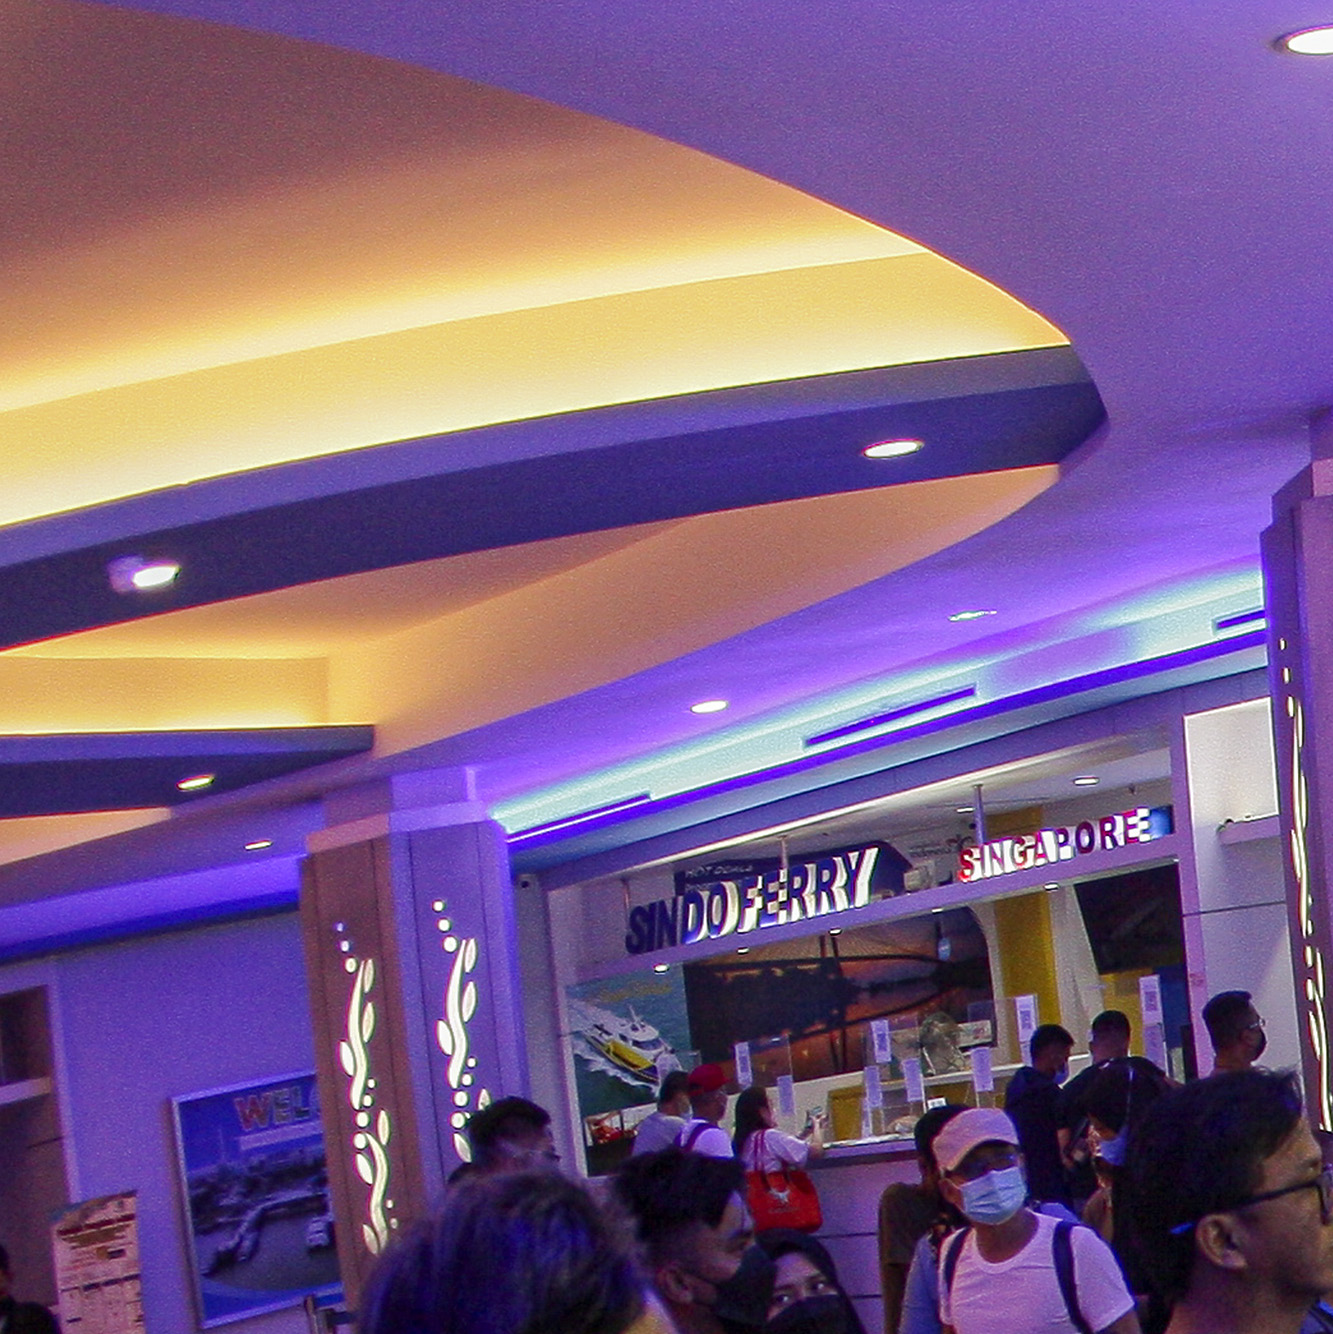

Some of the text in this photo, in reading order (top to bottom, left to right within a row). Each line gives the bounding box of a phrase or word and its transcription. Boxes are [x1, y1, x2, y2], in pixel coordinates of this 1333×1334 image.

[957, 806, 1151, 883] SINGAPORE
[736, 847, 879, 933] FERRY
[234, 1086, 320, 1131] WEL
